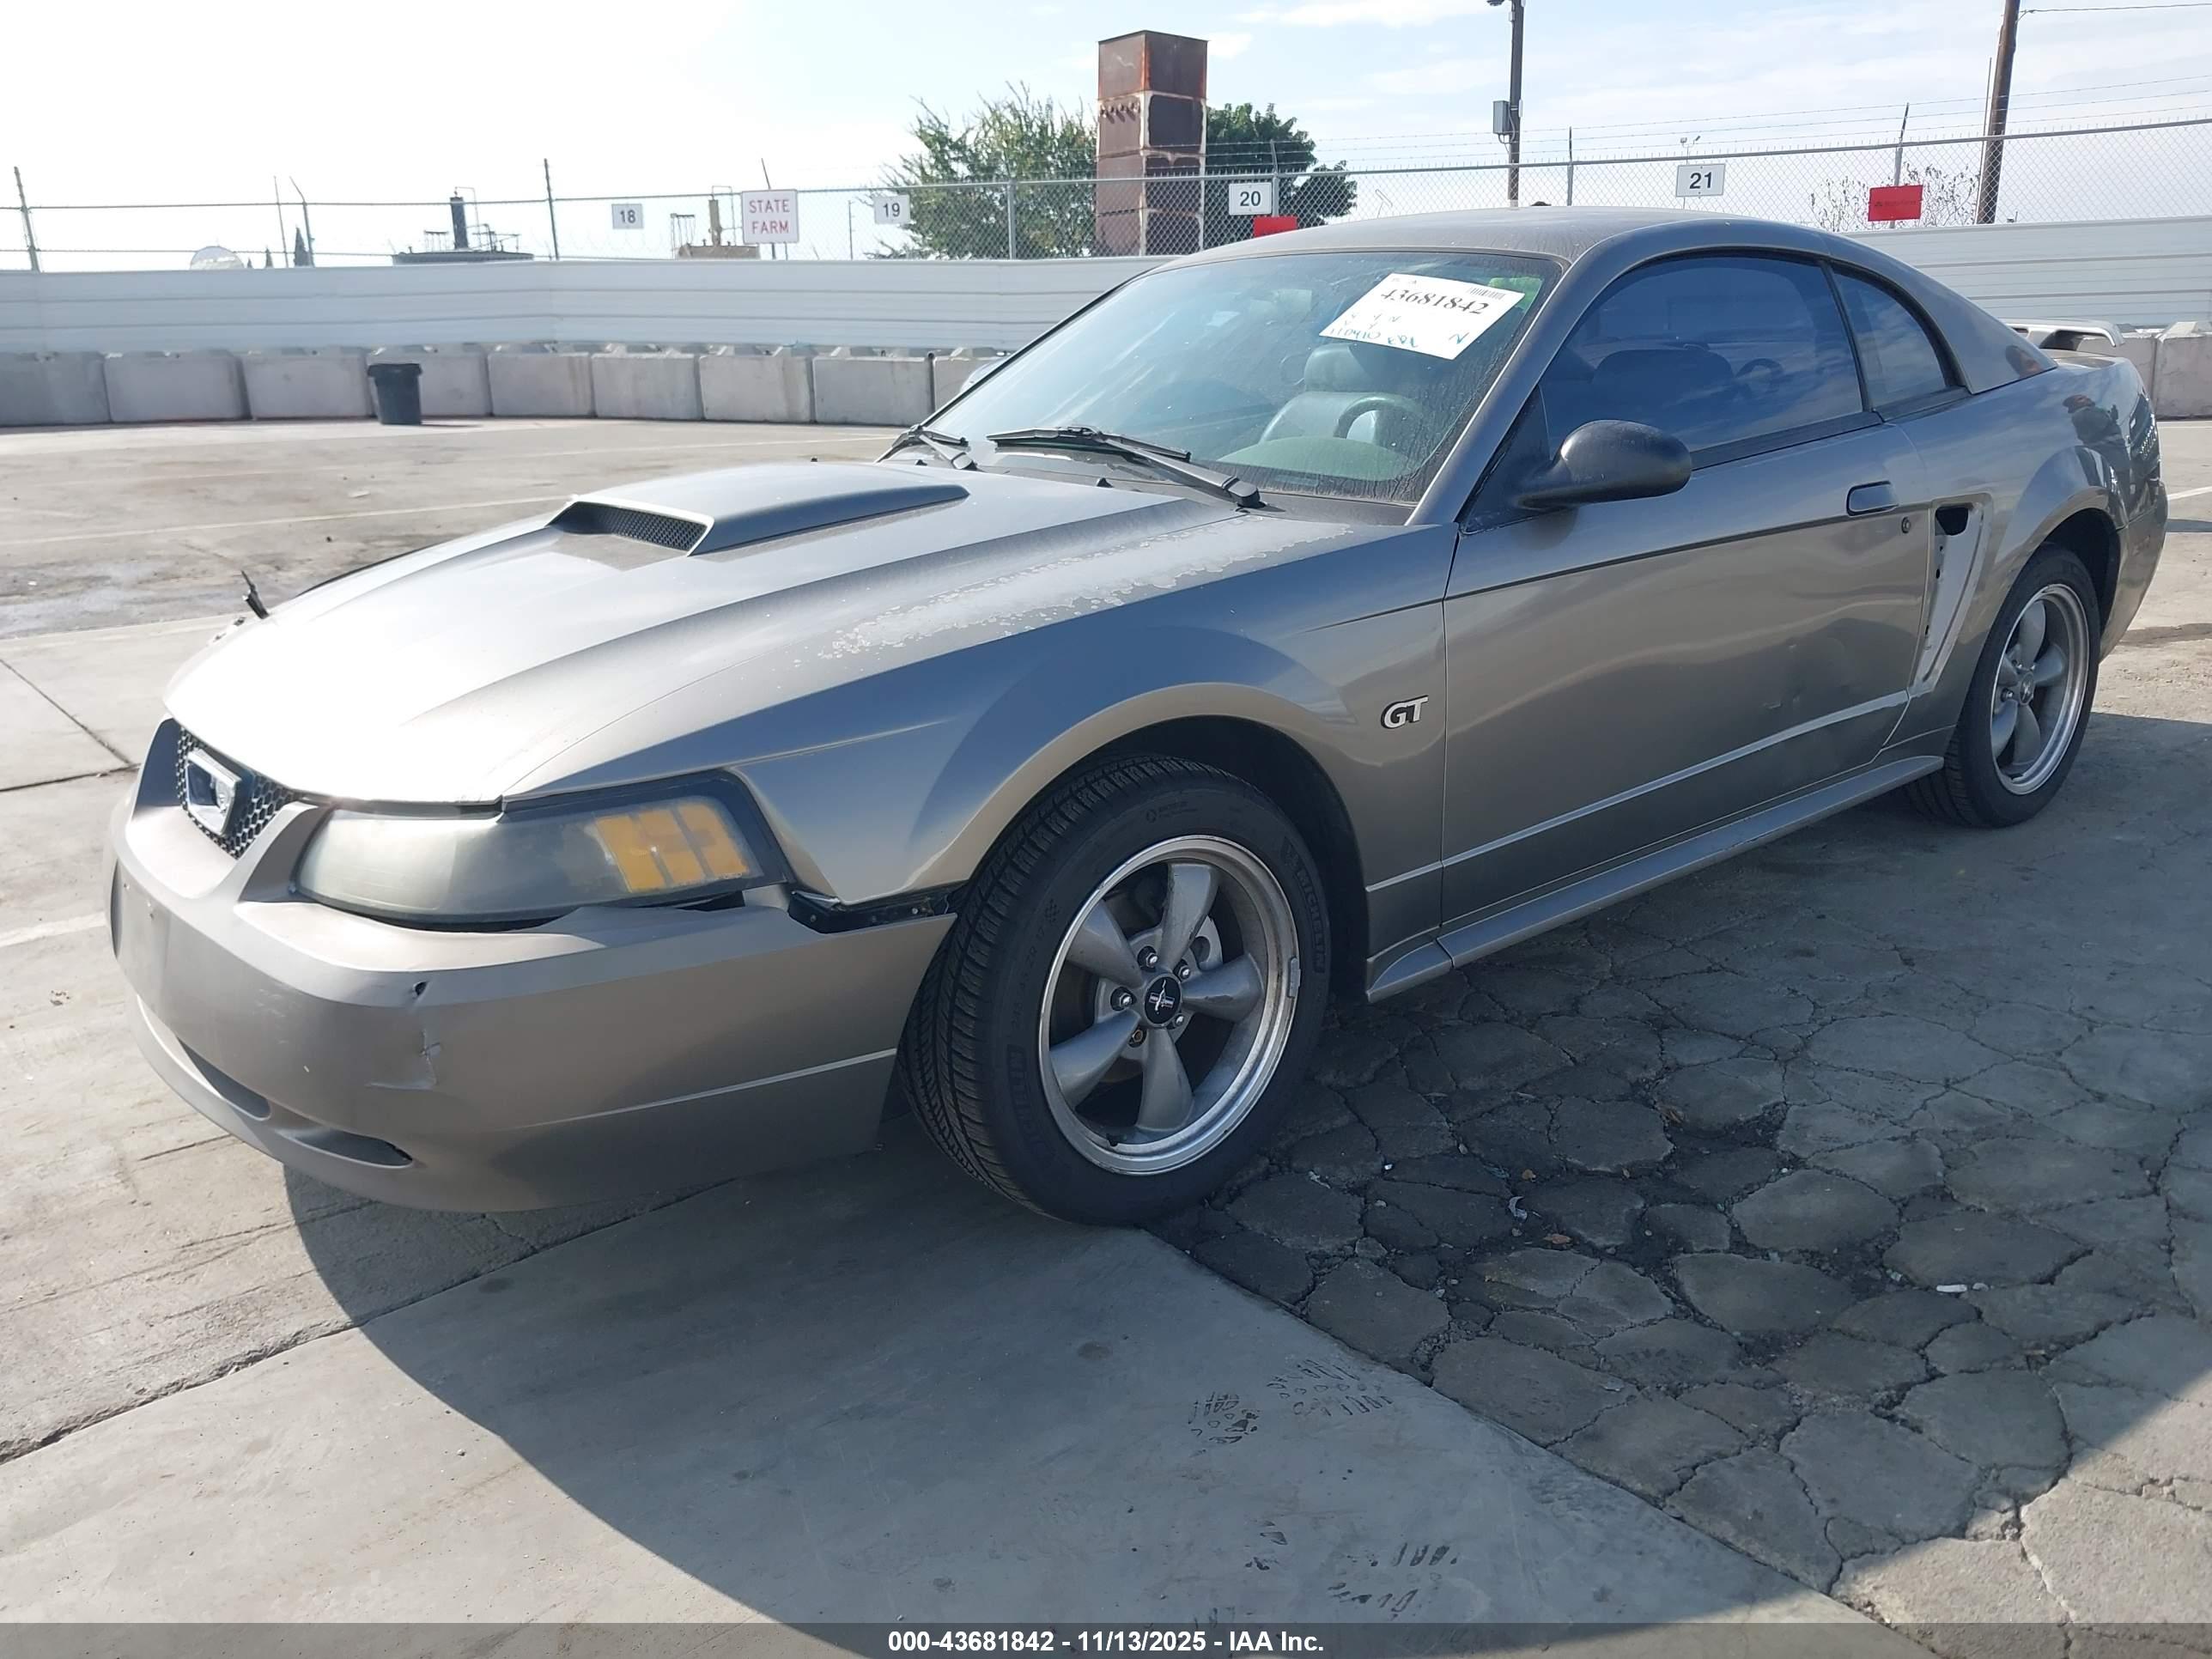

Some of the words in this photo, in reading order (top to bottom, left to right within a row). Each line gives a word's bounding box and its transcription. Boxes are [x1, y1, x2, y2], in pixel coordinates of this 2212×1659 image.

[1689, 172, 1711, 189] 21
[749, 198, 790, 214] STATE
[1240, 191, 1261, 207] 20
[620, 210, 636, 224] 18
[883, 203, 901, 218] 19
[751, 220, 789, 234] FARM
[1381, 289, 1490, 315] 43681842
[1381, 695, 1429, 729] GT
